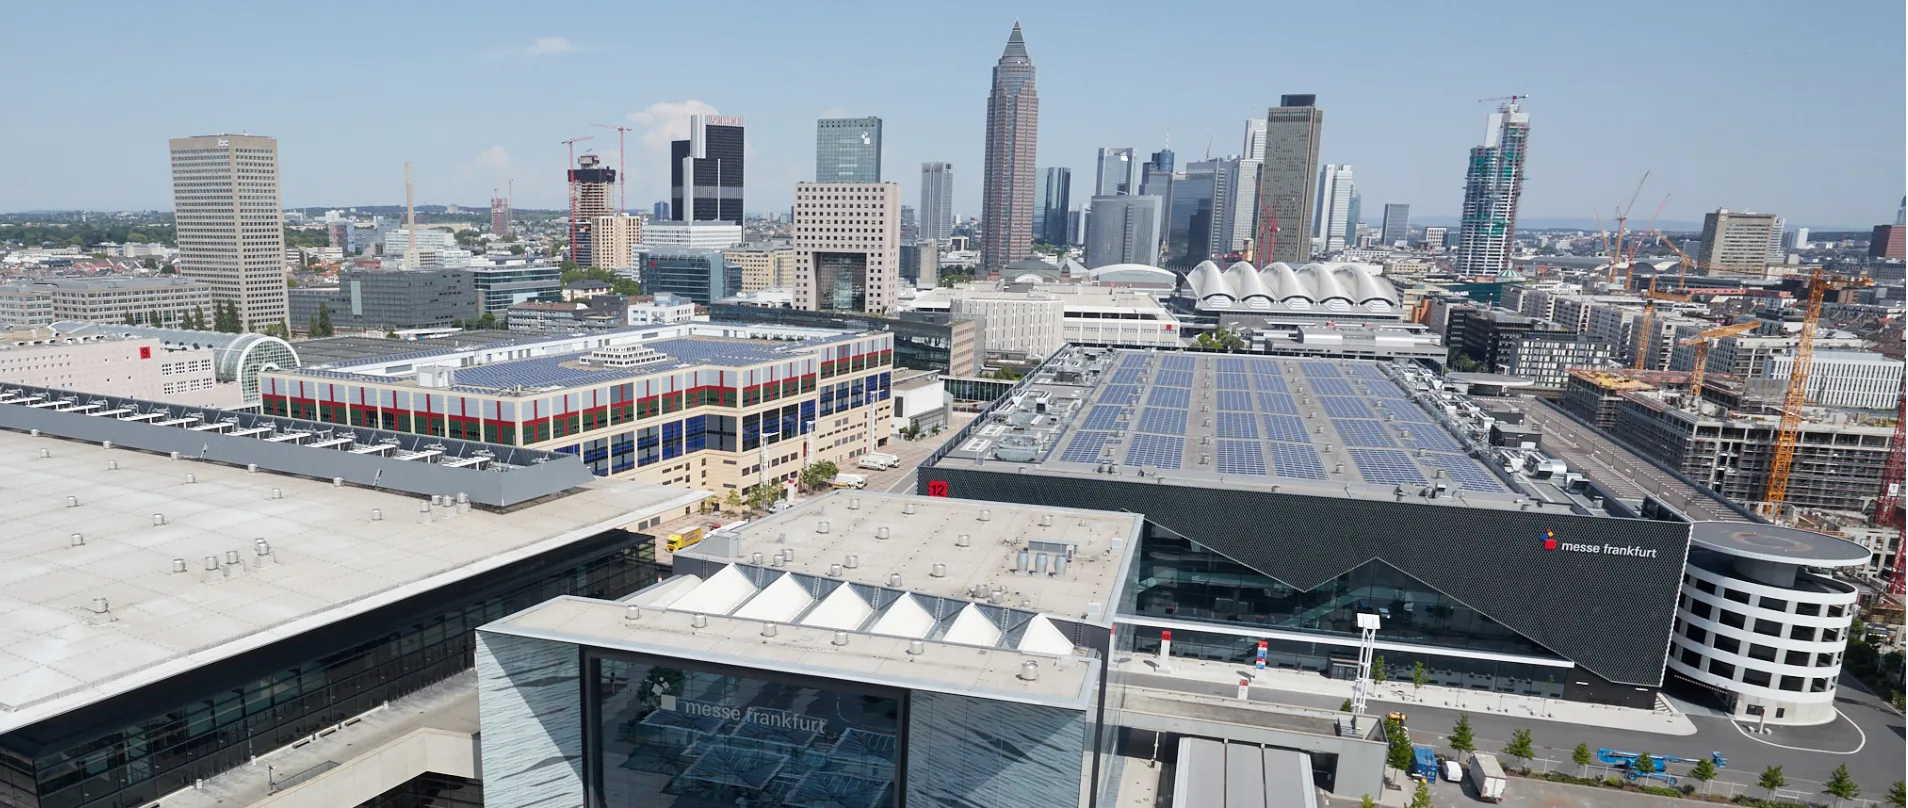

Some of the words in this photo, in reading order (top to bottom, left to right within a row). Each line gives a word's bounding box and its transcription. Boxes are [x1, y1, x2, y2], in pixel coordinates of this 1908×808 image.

[217, 138, 229, 147] ibc
[931, 484, 946, 496] 12
[1561, 542, 1600, 554] messe
[1603, 543, 1657, 558] frankfurt
[685, 701, 740, 721] messe
[745, 706, 829, 734] frankfurt
